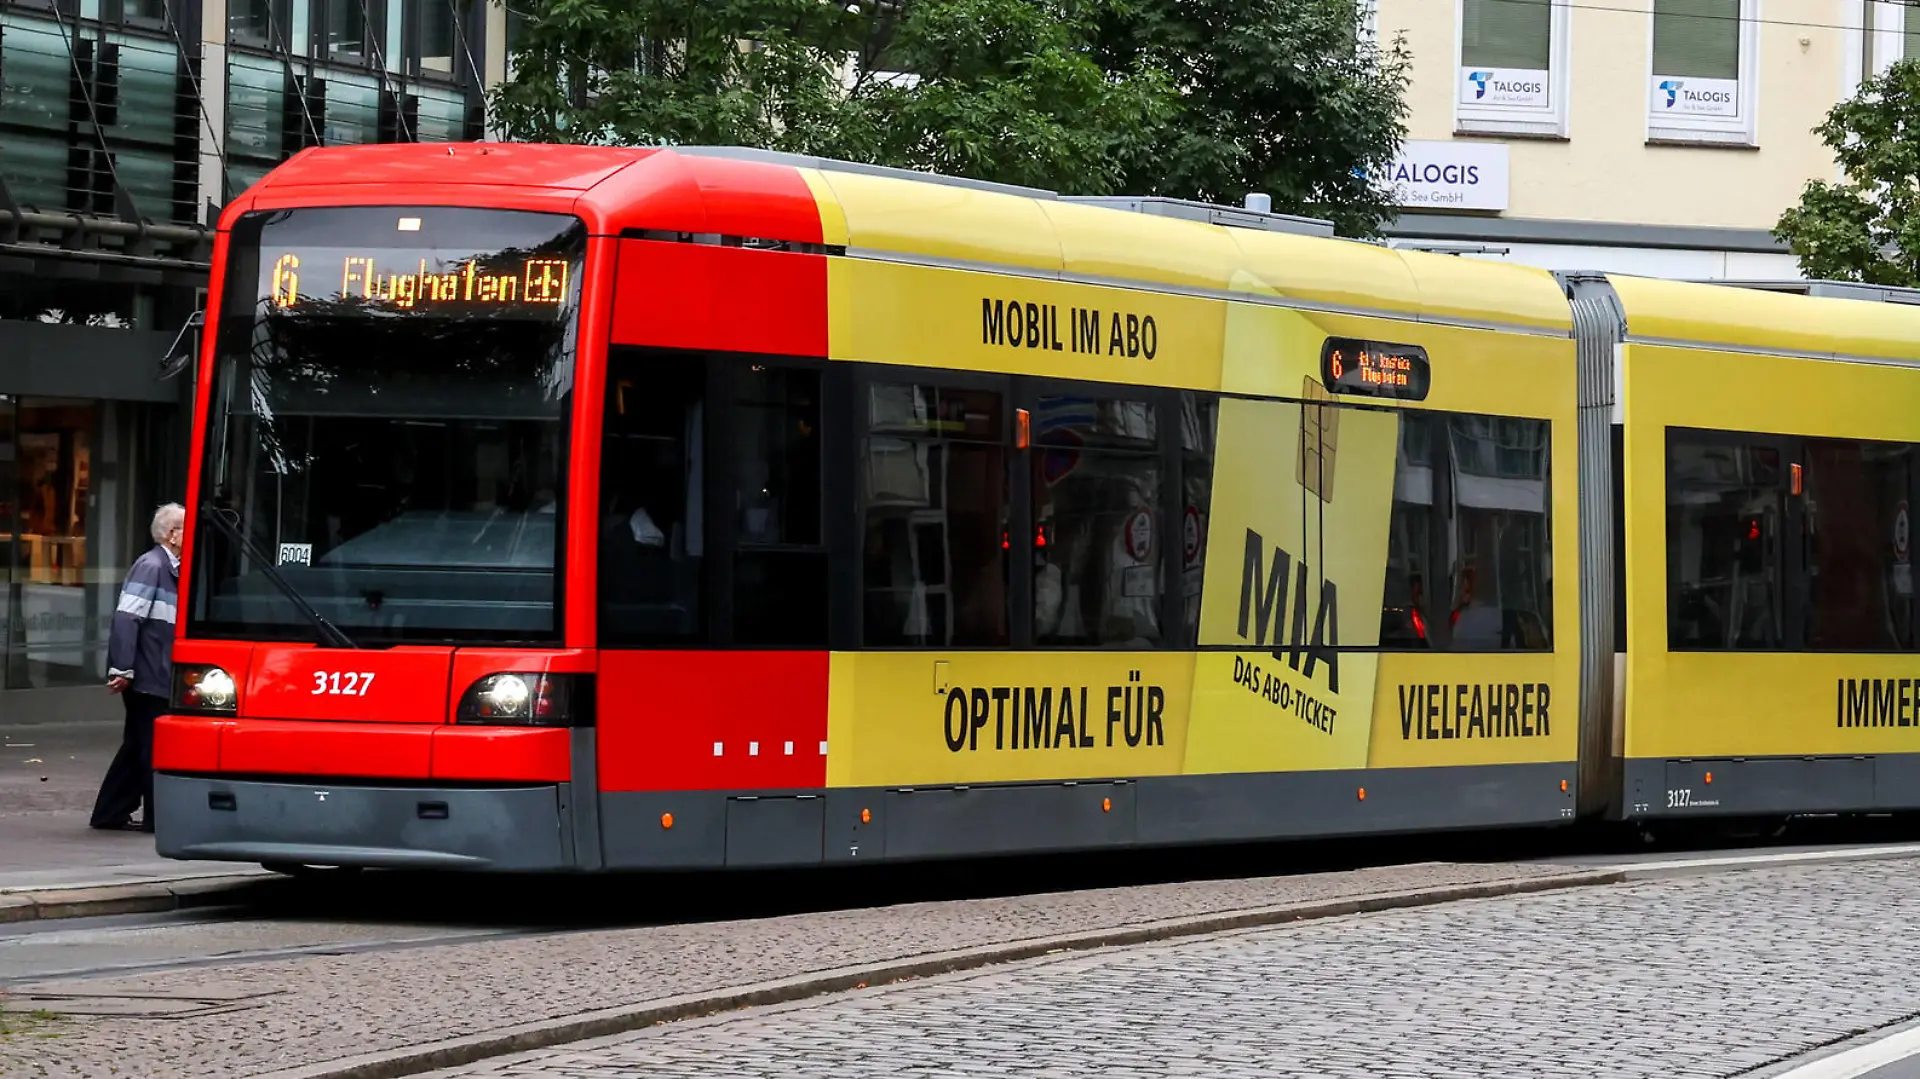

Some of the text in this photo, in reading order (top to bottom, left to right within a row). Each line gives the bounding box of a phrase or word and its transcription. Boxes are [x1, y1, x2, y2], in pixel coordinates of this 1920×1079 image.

[1493, 81, 1541, 93] TALOGIS
[1683, 90, 1730, 103] TALOGIS
[1384, 161, 1479, 185] TALOGIS
[1411, 190, 1428, 202] Sea
[1430, 191, 1463, 203] GmbH
[271, 253, 517, 308] 6 Flughafen
[982, 298, 1157, 360] MOBIL IM ABO
[1331, 350, 1343, 380] 6
[1237, 527, 1339, 695] MIA
[311, 670, 376, 697] 3127
[1232, 654, 1337, 736] DAS ABO-TICKET
[944, 670, 1164, 752] OPTIMAL FÜR
[1398, 683, 1551, 740] VIELFAHRER
[1667, 789, 1691, 808] 3127
